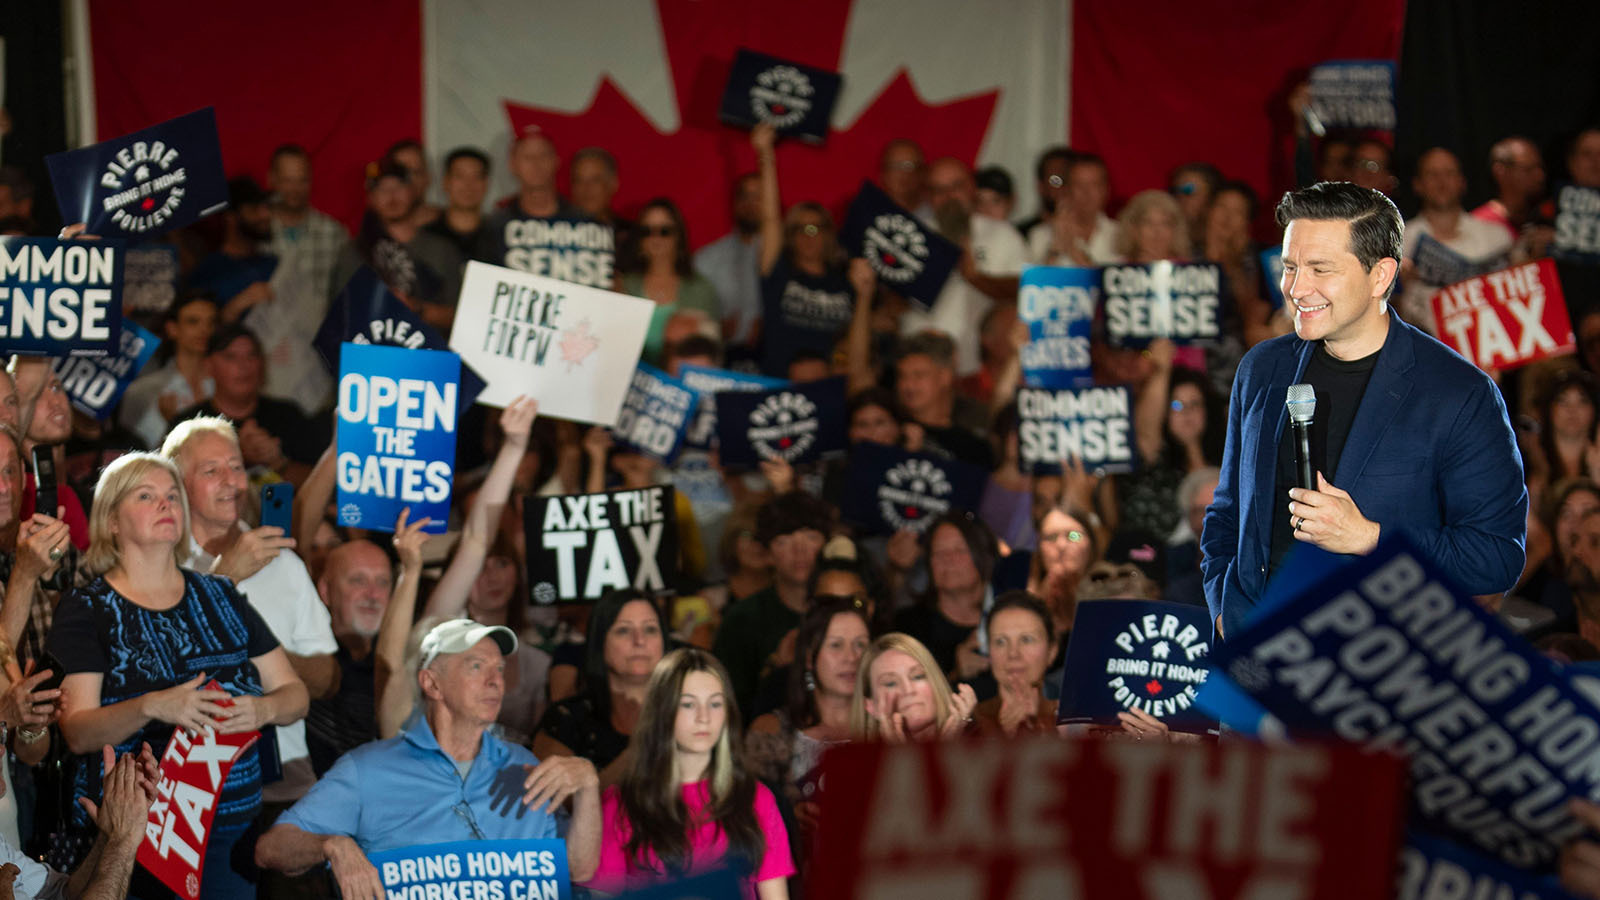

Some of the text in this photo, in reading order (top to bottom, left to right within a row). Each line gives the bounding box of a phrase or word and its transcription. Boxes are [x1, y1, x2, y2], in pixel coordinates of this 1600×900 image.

[101, 140, 179, 189] PIERRE
[103, 167, 187, 212] BRING IT HOME
[111, 186, 185, 232] POILIEVRE
[505, 219, 615, 251] COMMON
[505, 248, 615, 289] SENSE
[1440, 263, 1543, 318] AXE THE
[490, 280, 566, 330] PIERRE
[1018, 284, 1098, 323] OPEN
[1105, 296, 1220, 336] SENSE
[1020, 336, 1092, 371] GATES
[1444, 296, 1558, 366] TAX
[338, 373, 457, 433] OPEN
[1018, 387, 1129, 418] COMMON
[372, 426, 417, 457] THE
[1019, 418, 1131, 463] SENSE
[338, 451, 452, 503] GATES
[543, 487, 664, 531] AXE THE
[542, 522, 665, 599] TAX
[1115, 613, 1209, 661] PIERRE
[1358, 552, 1532, 704] BRING
[1106, 658, 1150, 677] BRING
[1151, 661, 1167, 679] IT
[1167, 664, 1209, 684] HOME
[1108, 675, 1199, 717] POILIEVRE
[146, 767, 176, 851] AXE
[159, 722, 240, 871] TAX
[860, 742, 1328, 866] AXE THE
[382, 851, 556, 887] BRING HOMES
[387, 879, 559, 900] WORKERS CAN
